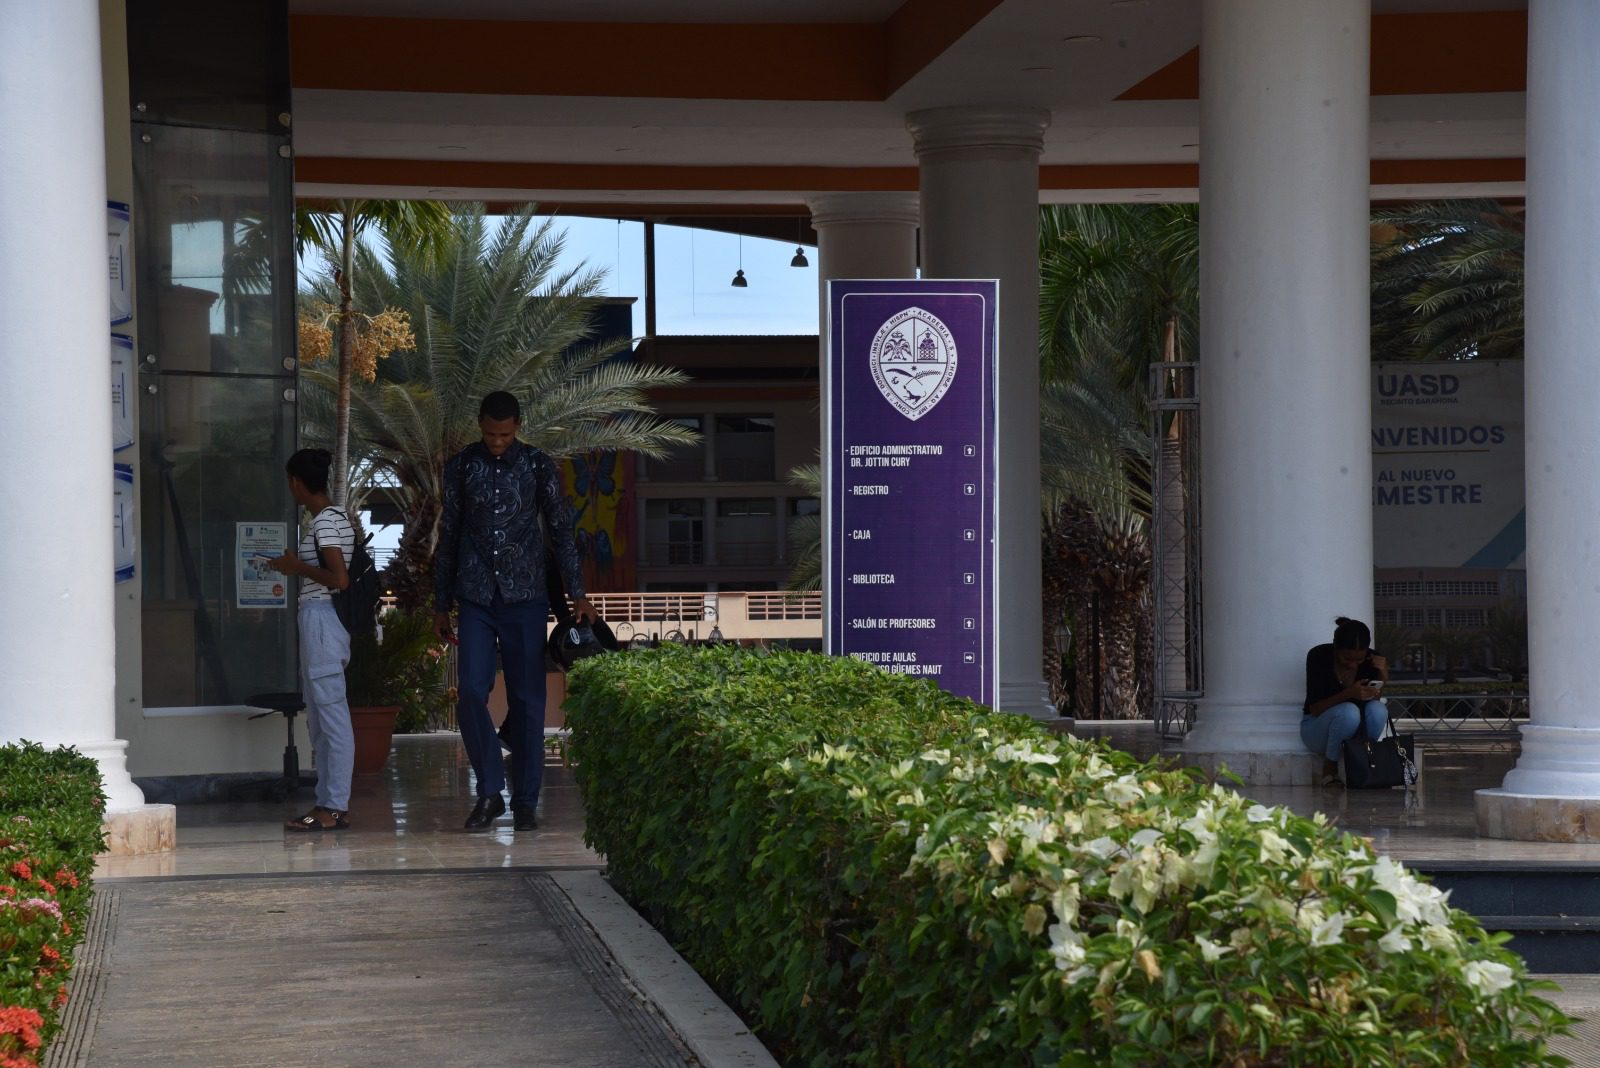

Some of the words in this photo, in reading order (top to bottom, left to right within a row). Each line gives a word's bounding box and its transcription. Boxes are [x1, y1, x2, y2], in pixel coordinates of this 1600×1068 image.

[917, 310, 950, 338] ACADEMIA
[1377, 374, 1460, 397] UASD
[1372, 425, 1505, 446] NVENIDOS
[850, 445, 880, 455] EDIFICIO
[882, 445, 943, 455] ADMINISTRATIVO
[851, 457, 863, 467] DR.
[865, 457, 890, 467] JOTTIN
[891, 457, 911, 467] CURY
[1378, 470, 1396, 482] AL
[1401, 469, 1456, 481] NUEVO
[853, 485, 889, 495] REGISTRO
[1372, 484, 1482, 506] MESTRE
[853, 530, 871, 540] CAJA
[853, 574, 895, 584] BIBLIOTECA
[853, 617, 876, 628] SALÓN
[878, 619, 888, 628] DE
[889, 619, 936, 628] PROFESORES
[881, 652, 891, 662] DE
[892, 652, 916, 662] AULAS
[922, 664, 943, 674] NAUT
